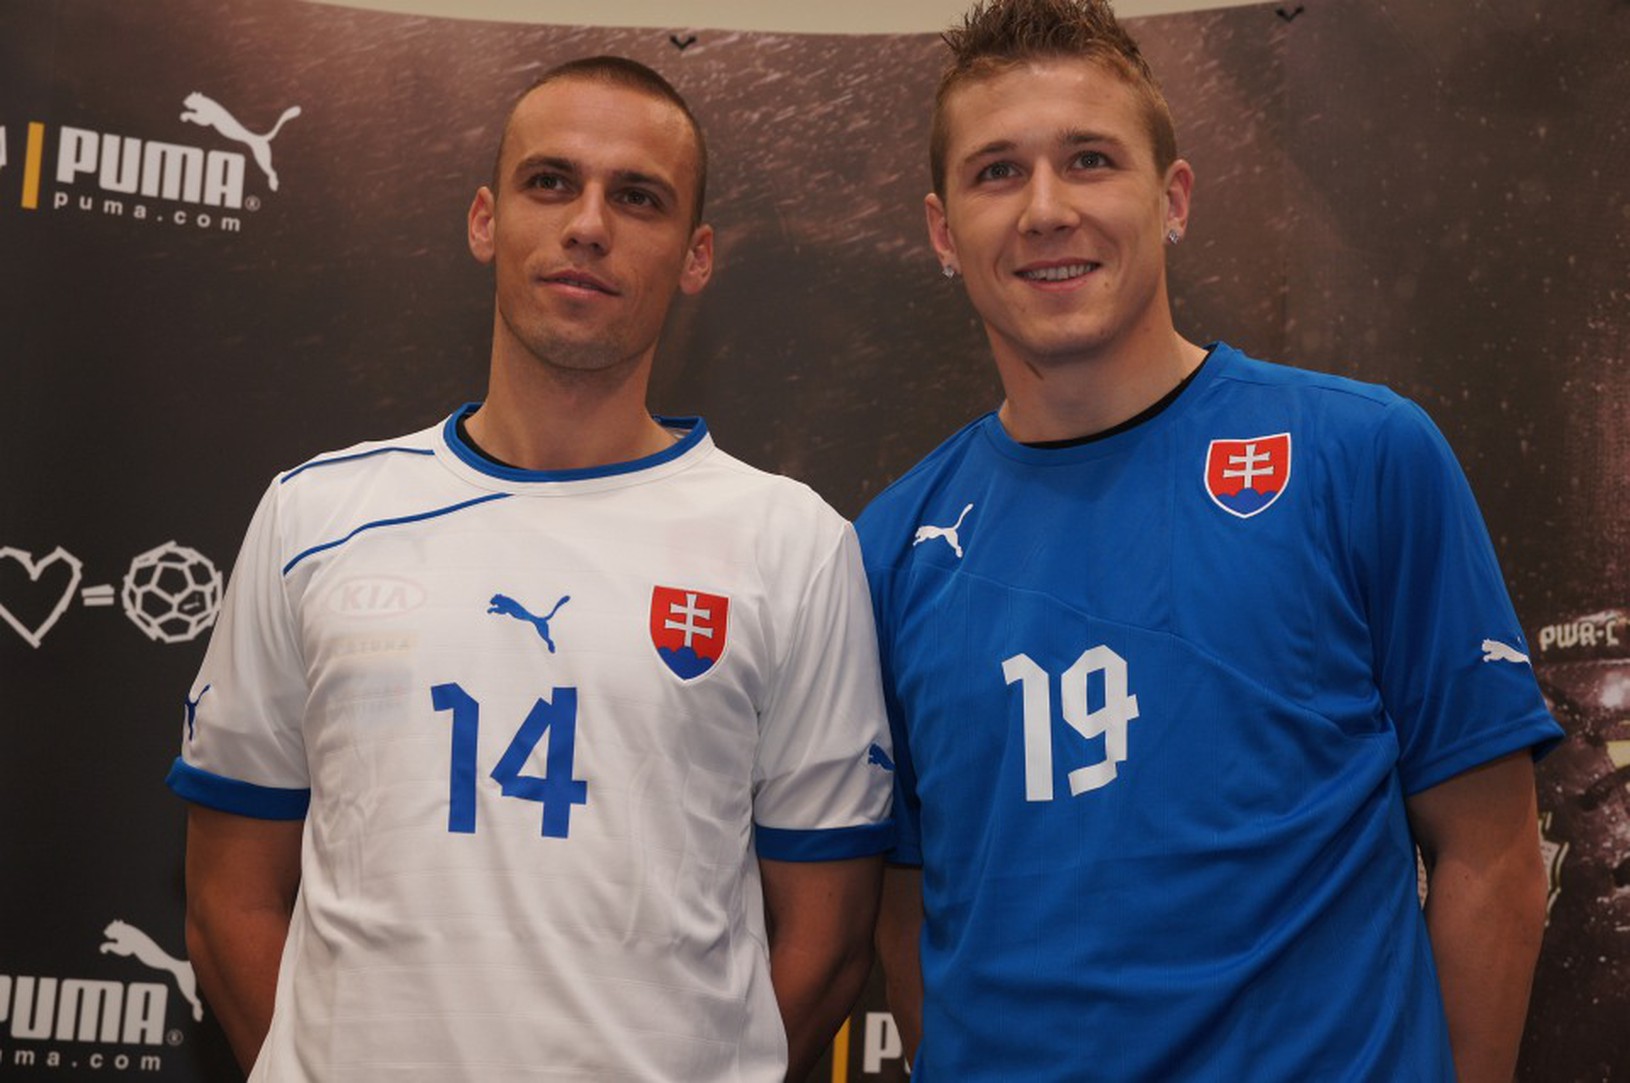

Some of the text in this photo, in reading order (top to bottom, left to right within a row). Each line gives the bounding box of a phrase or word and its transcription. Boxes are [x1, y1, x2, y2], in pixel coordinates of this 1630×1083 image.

[56, 125, 246, 210] PUMA
[53, 190, 241, 232] puma.com
[431, 682, 588, 839] 14
[1001, 644, 1140, 801] 19
[0, 974, 169, 1046] UMA
